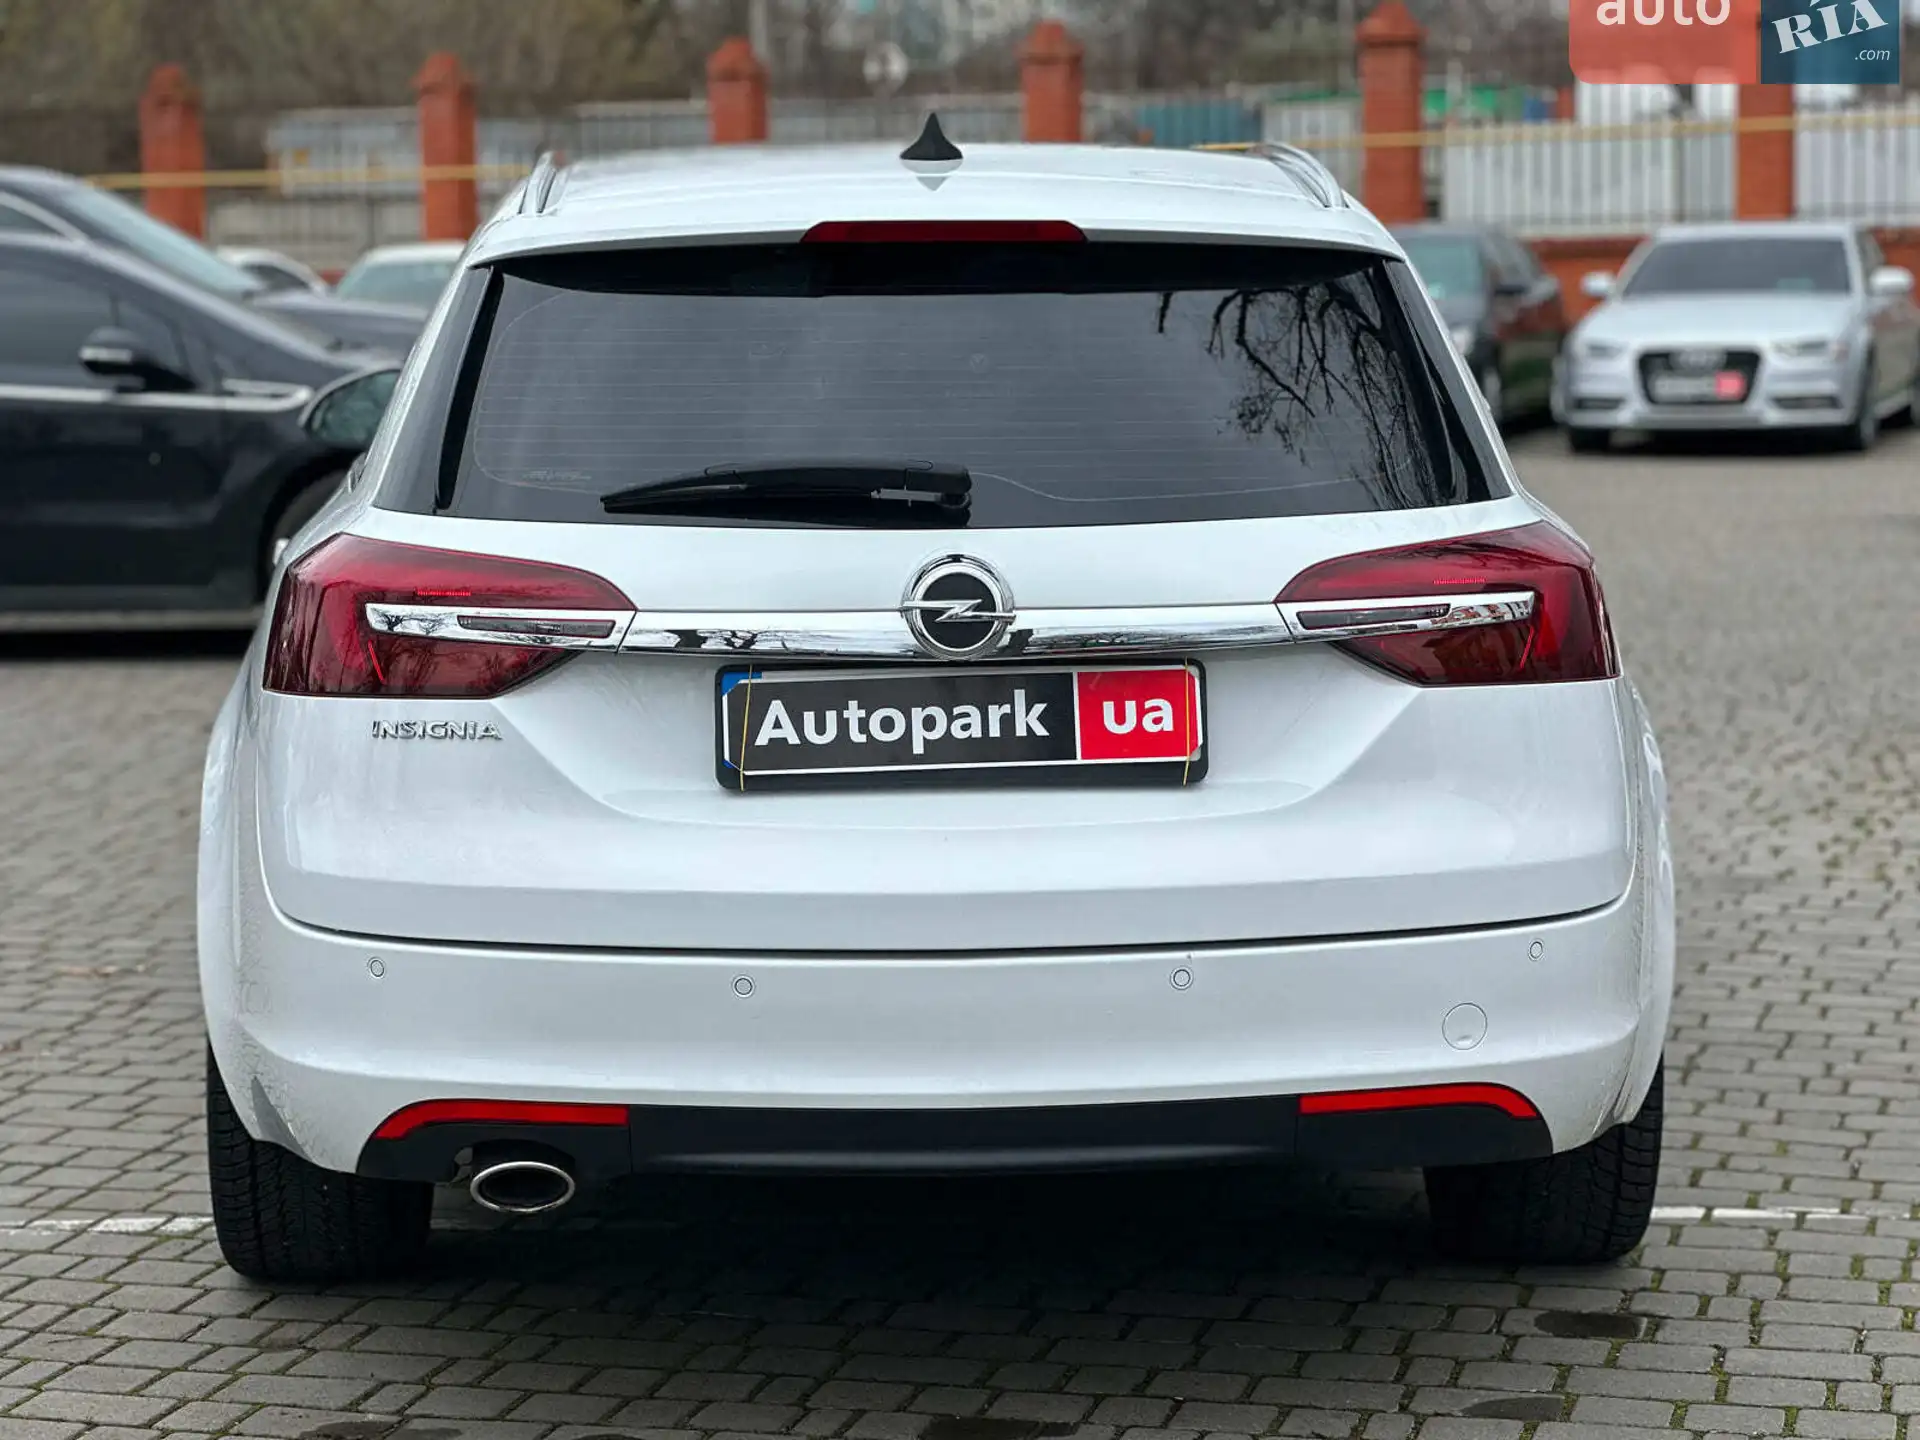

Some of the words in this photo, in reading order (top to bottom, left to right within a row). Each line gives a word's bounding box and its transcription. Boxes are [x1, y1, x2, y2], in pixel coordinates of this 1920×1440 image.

[371, 720, 503, 741] INSIGNIA
[754, 689, 1050, 754] Autopark
[1102, 697, 1175, 735] ua
